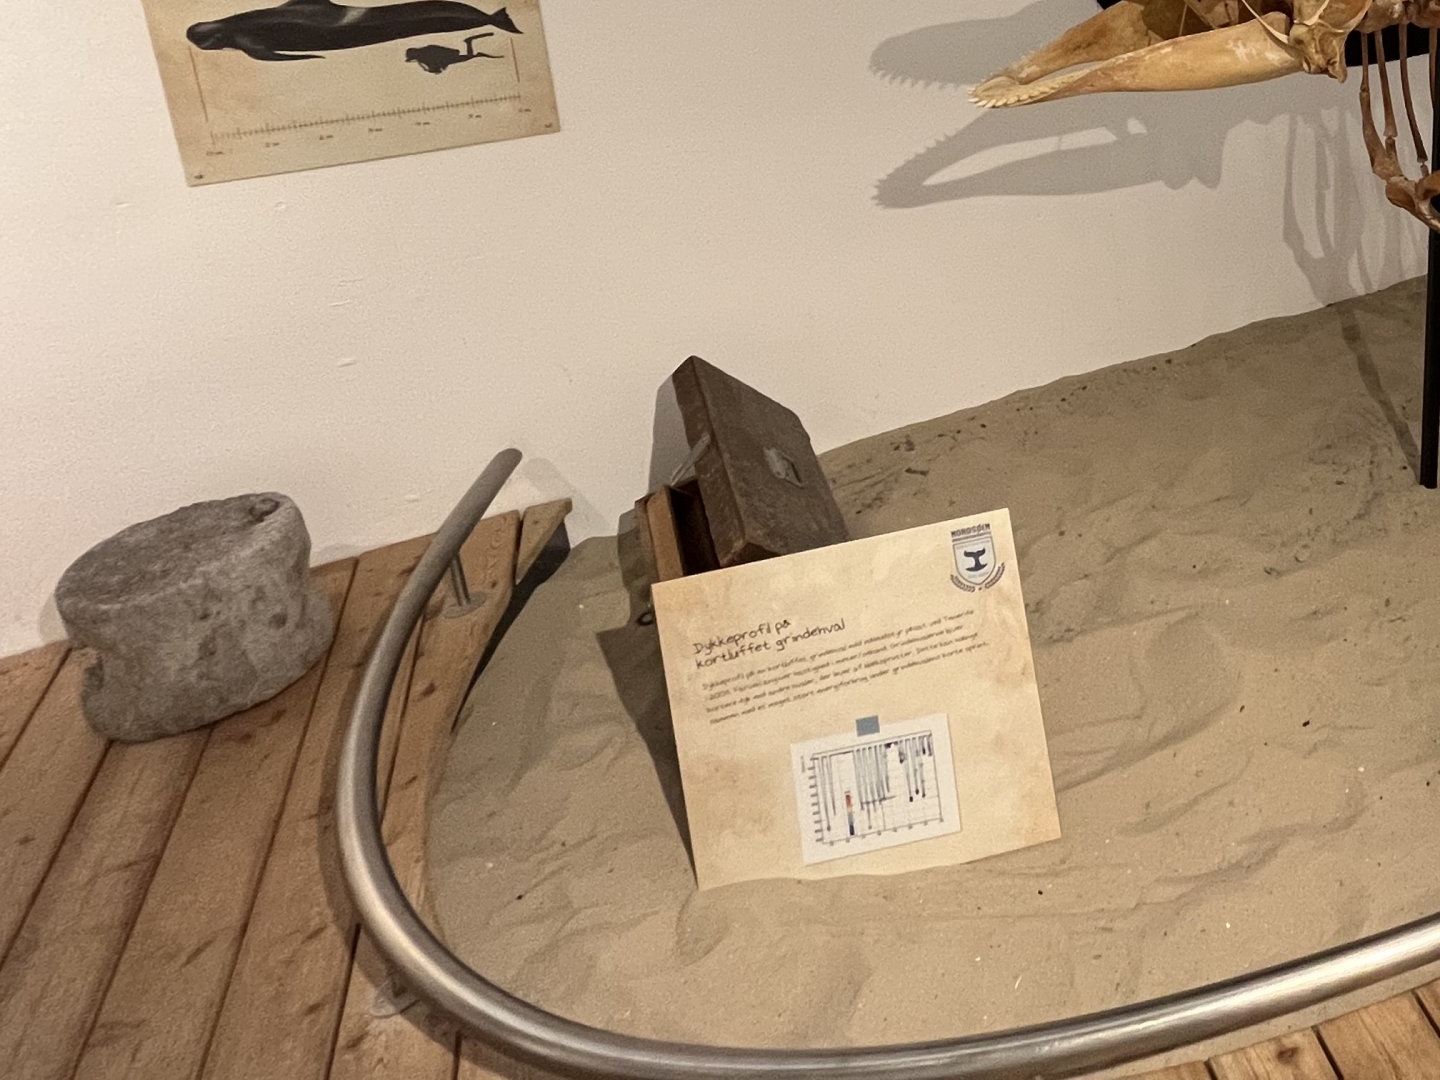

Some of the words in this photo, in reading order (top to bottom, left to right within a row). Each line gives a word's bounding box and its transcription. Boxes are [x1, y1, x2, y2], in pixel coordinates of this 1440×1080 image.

[692, 621, 772, 656] Dykkeprofil
[695, 640, 772, 670] kortluffet
[775, 617, 846, 652] grindehval
